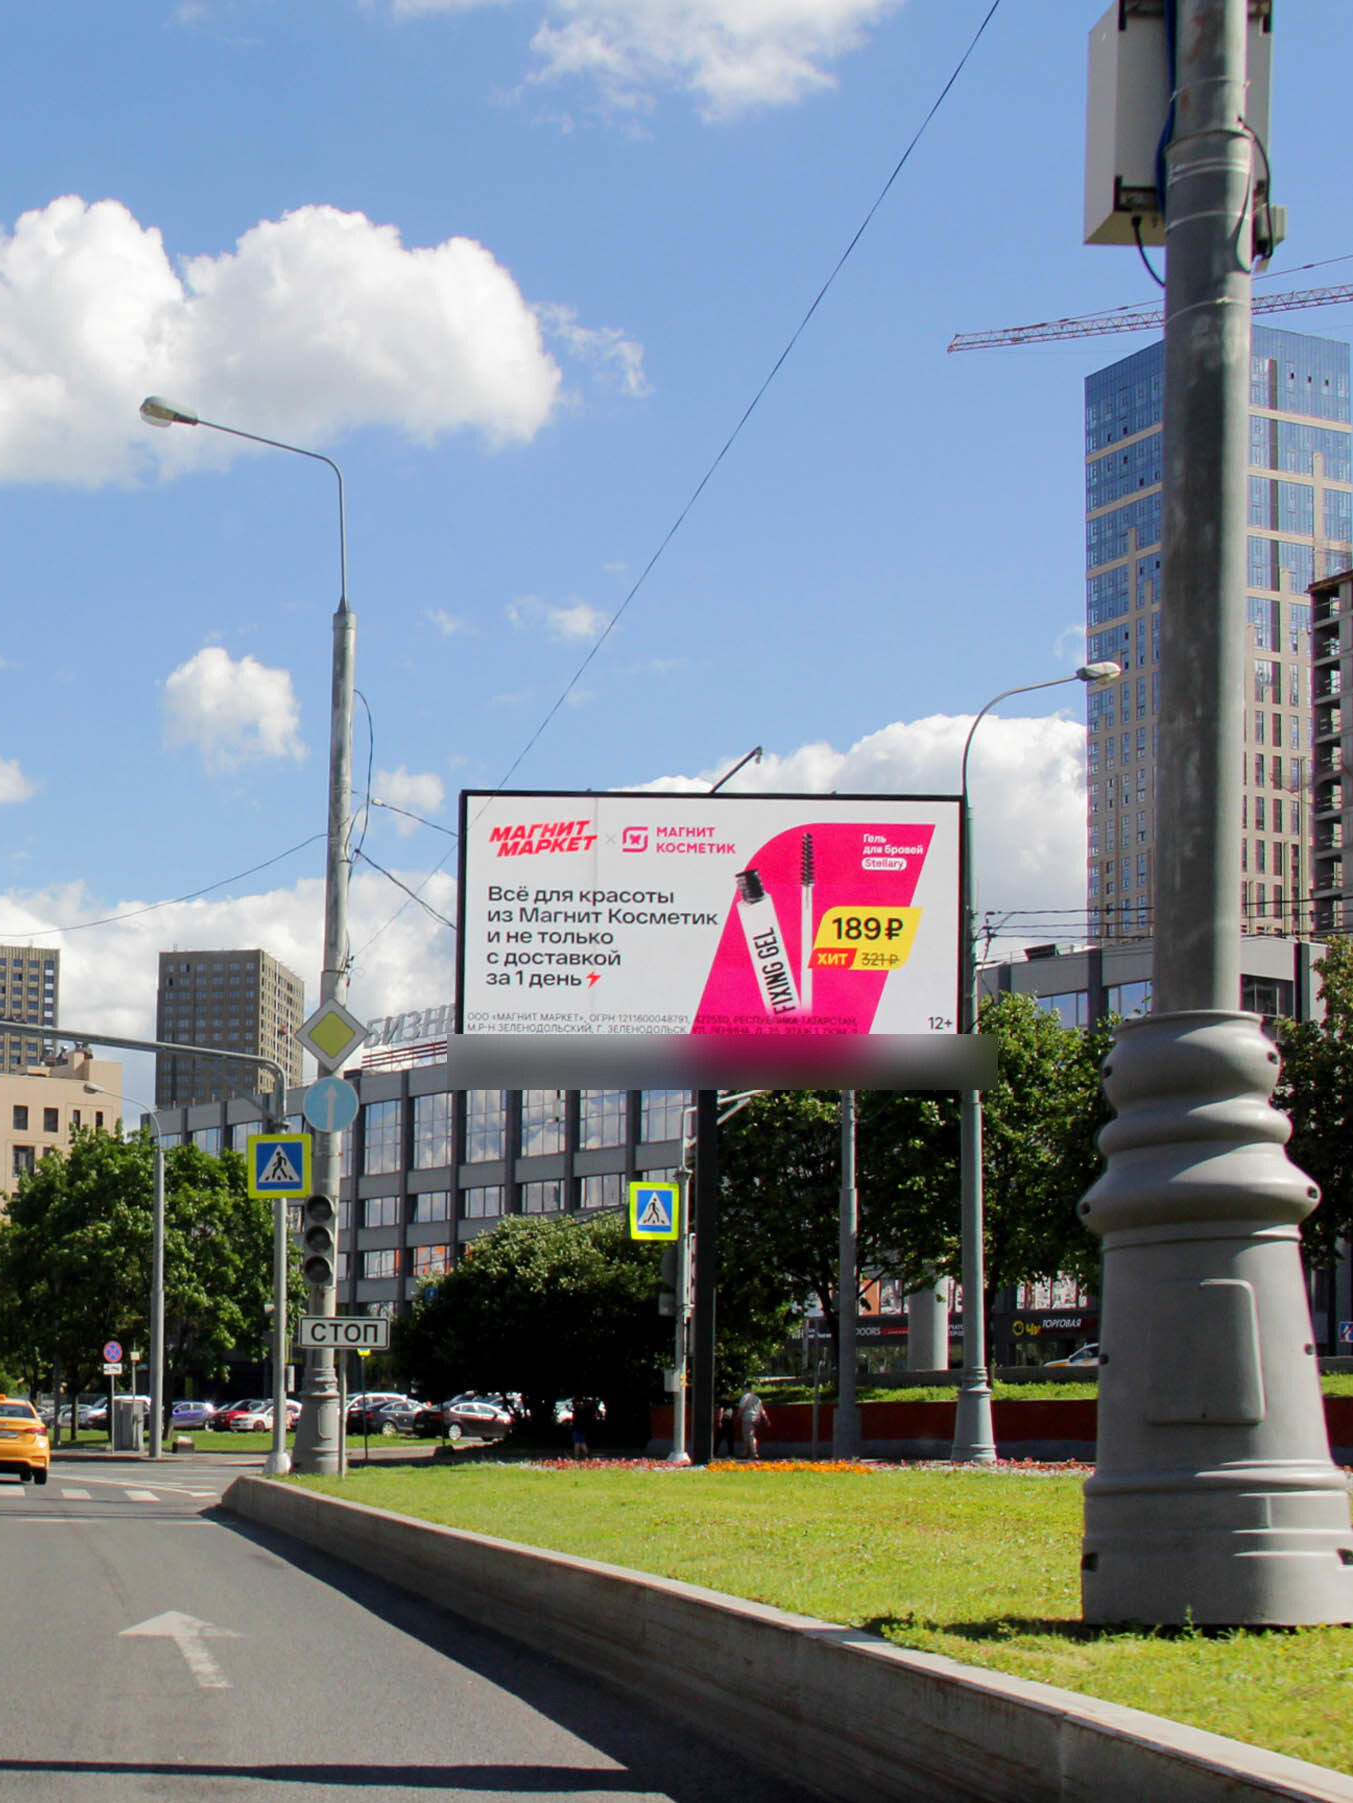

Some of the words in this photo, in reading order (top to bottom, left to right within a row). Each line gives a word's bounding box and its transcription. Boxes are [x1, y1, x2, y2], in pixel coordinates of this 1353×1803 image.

[489, 820, 592, 843] МАГНИТ
[656, 827, 716, 838] МАГНИТ
[863, 834, 887, 844] Гель
[496, 835, 598, 858] МАРКЕТ
[656, 843, 737, 854] КОСМЕТИК
[862, 846, 883, 855] для
[884, 844, 924, 857] бровей
[865, 859, 904, 870] Stellary
[488, 886, 529, 901] Всё
[534, 890, 574, 904] для
[579, 890, 674, 907] красоты
[487, 909, 513, 922] из
[519, 907, 601, 924] Магнит
[608, 908, 718, 925] Косметик
[487, 930, 501, 943] и
[506, 931, 532, 944] не
[537, 931, 614, 945] только
[753, 926, 780, 960] GEL
[486, 951, 499, 964] с
[503, 949, 621, 967] доставкой
[817, 953, 849, 966] ХИТ
[486, 972, 510, 986] за
[515, 970, 524, 985] 1
[529, 972, 581, 988] день
[762, 962, 797, 1015] FIXING
[467, 1013, 489, 1021] ООО
[492, 1013, 537, 1021] «МАГНИТ
[589, 1014, 615, 1022] ОГРН
[928, 1017, 953, 1030] 12+
[311, 1323, 378, 1342] СТОП
